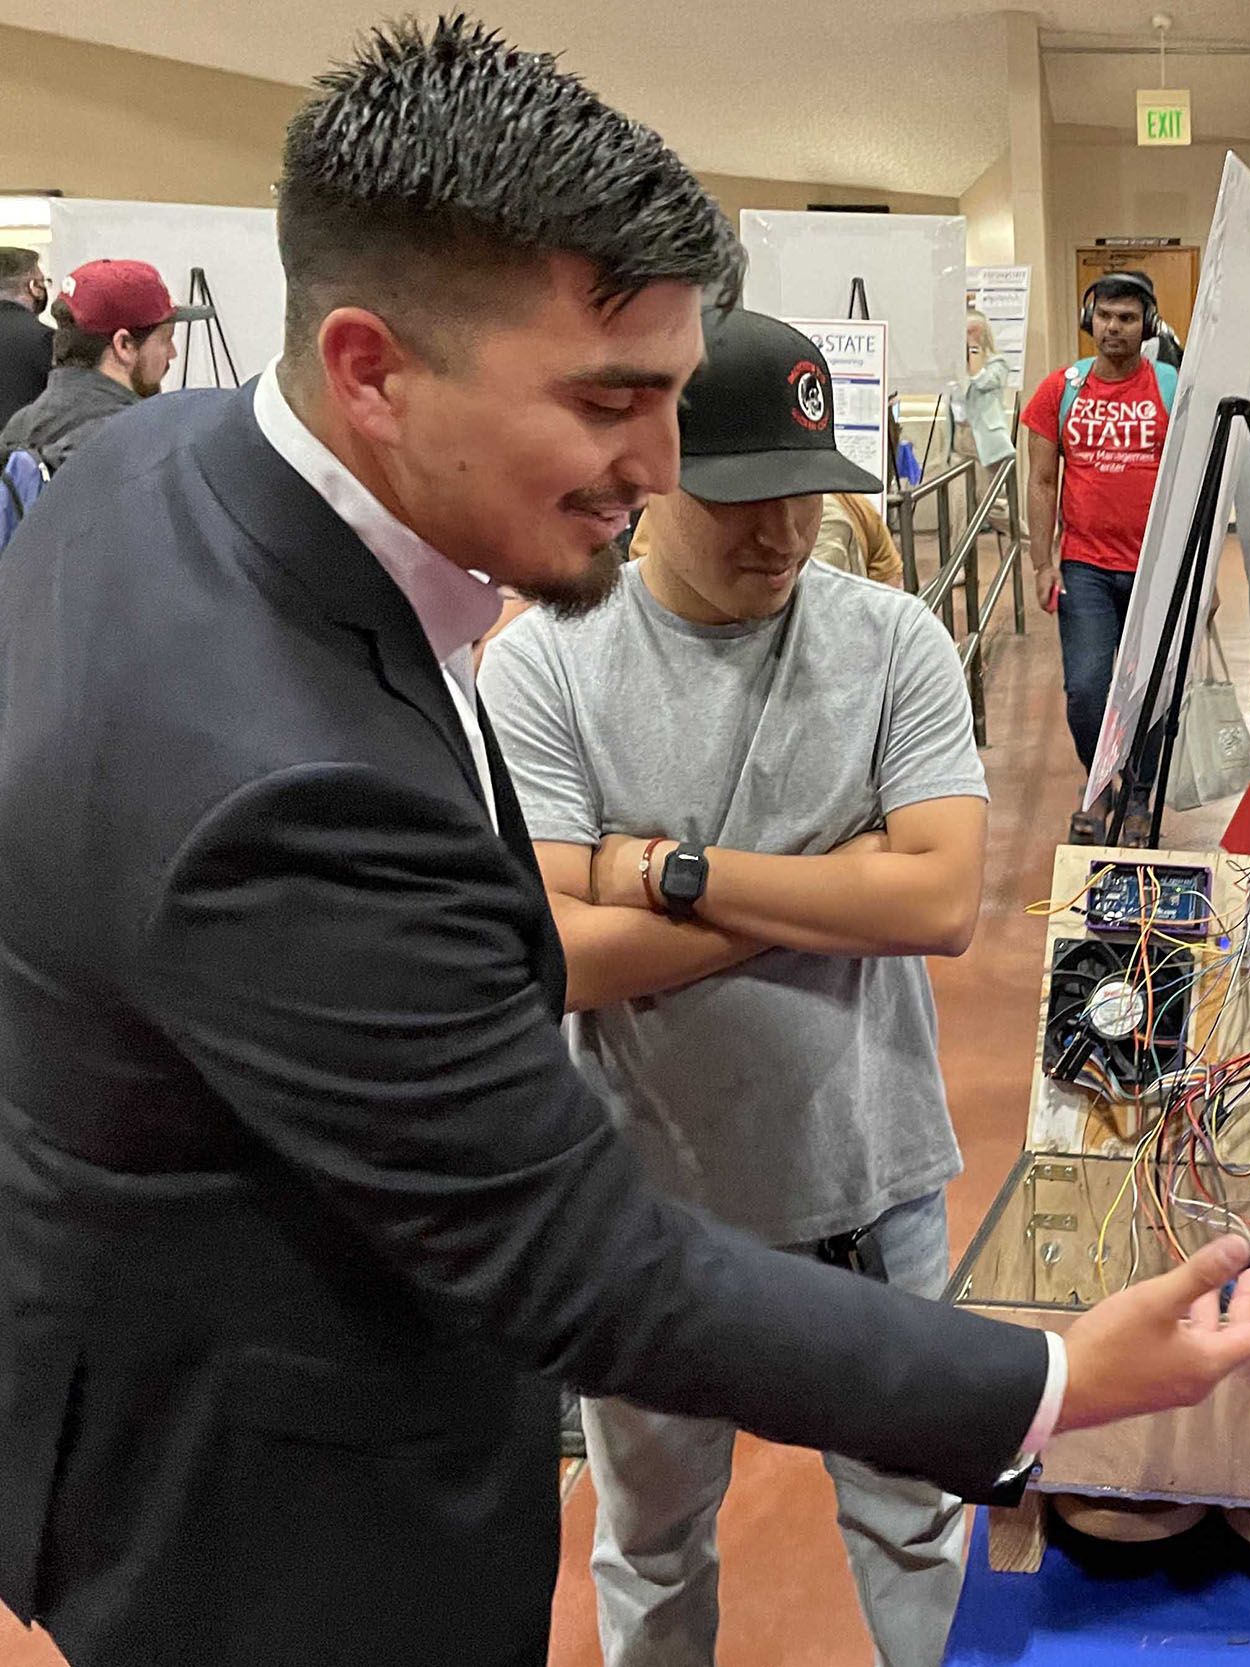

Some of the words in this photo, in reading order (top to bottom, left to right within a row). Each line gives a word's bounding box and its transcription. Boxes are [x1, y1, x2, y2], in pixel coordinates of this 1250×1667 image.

[1147, 110, 1183, 138] EXIT
[825, 335, 876, 353] STATE
[1071, 397, 1157, 421] FRESNO
[1067, 417, 1157, 449] STATE
